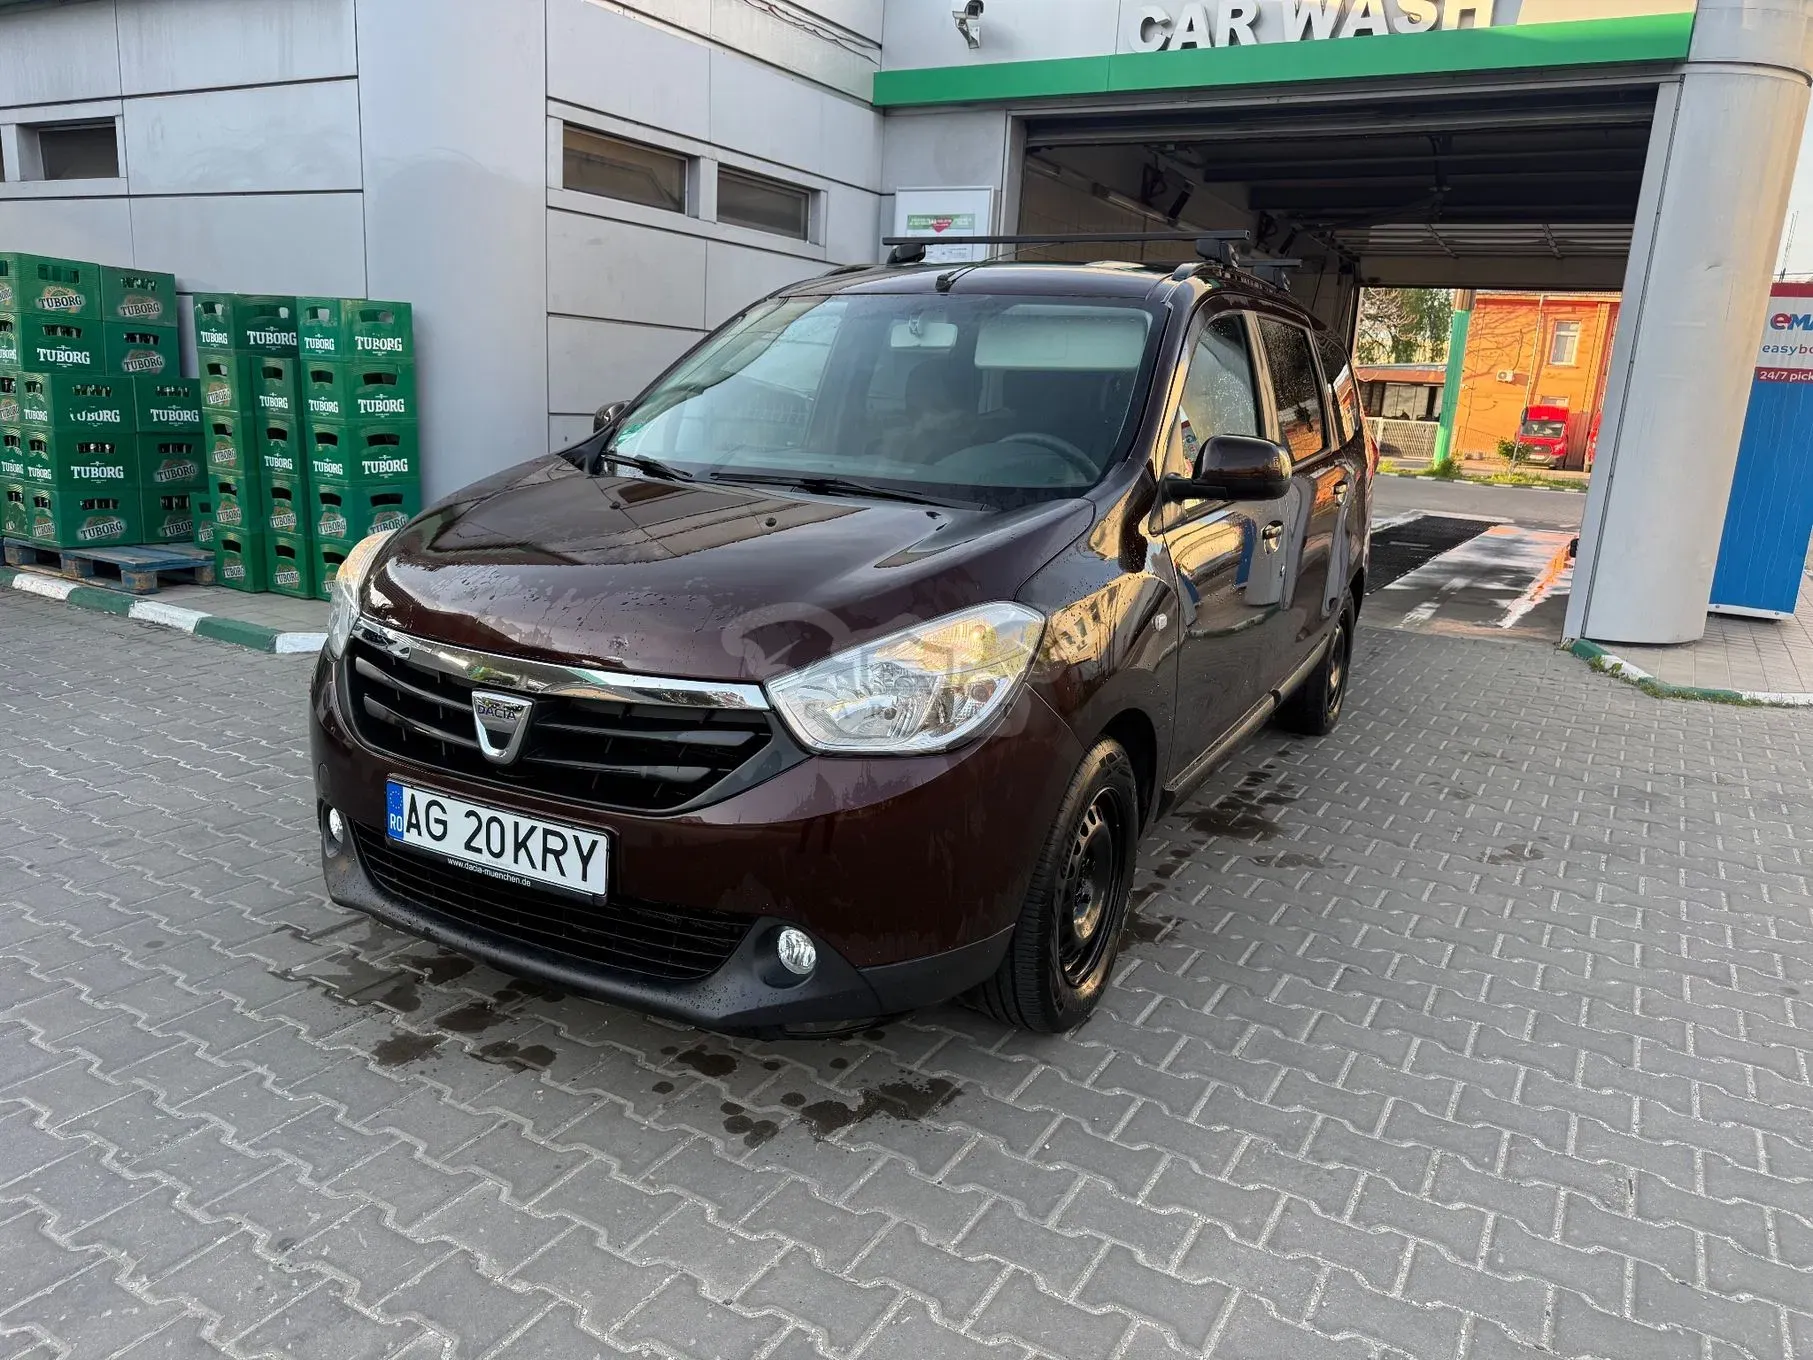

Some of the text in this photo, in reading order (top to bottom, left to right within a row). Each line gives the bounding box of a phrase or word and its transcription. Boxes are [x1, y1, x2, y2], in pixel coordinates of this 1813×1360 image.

[1128, 0, 1491, 52] CAR WASH
[38, 295, 82, 309] TUBORG
[120, 301, 160, 316] TUBORG
[1770, 313, 1813, 331] eM
[201, 331, 228, 345] TUBORG
[246, 330, 297, 346] TUBORG
[304, 337, 335, 350] TUBORG
[355, 336, 402, 351] TUBORG
[0, 349, 17, 360] UBORG
[36, 348, 91, 364] TUBORG
[124, 356, 163, 372] TUBORG
[1760, 371, 1788, 381] 24/7
[208, 387, 231, 404] TUBORG
[259, 395, 288, 409] TUBORG
[309, 399, 338, 413] TUBORG
[358, 399, 405, 413] TUBORG
[24, 408, 48, 422] TUBORG
[150, 408, 199, 422] TUBORG
[213, 448, 236, 463] TUBORG
[264, 455, 293, 470] TUBORG
[1, 461, 24, 475] TUBORG
[28, 466, 52, 480] TUBORG
[71, 465, 124, 479] TUBORG
[157, 464, 196, 482] TUBORG
[313, 460, 343, 475] TUBORG
[362, 458, 408, 474] TUBORG
[216, 508, 241, 522] TUBORG
[271, 514, 296, 528] TUBORG
[33, 523, 55, 537] TUBORG
[81, 521, 123, 540] TUBORG
[162, 519, 192, 537] TUBOR
[320, 520, 346, 534] TUBORG
[223, 565, 245, 578] TUBORG
[275, 570, 299, 584] TUBORG
[478, 705, 517, 720] DACIA
[389, 813, 403, 833] RO
[405, 793, 599, 882] AG 20KRY
[447, 857, 531, 887] www.dacia-muenchen.de
